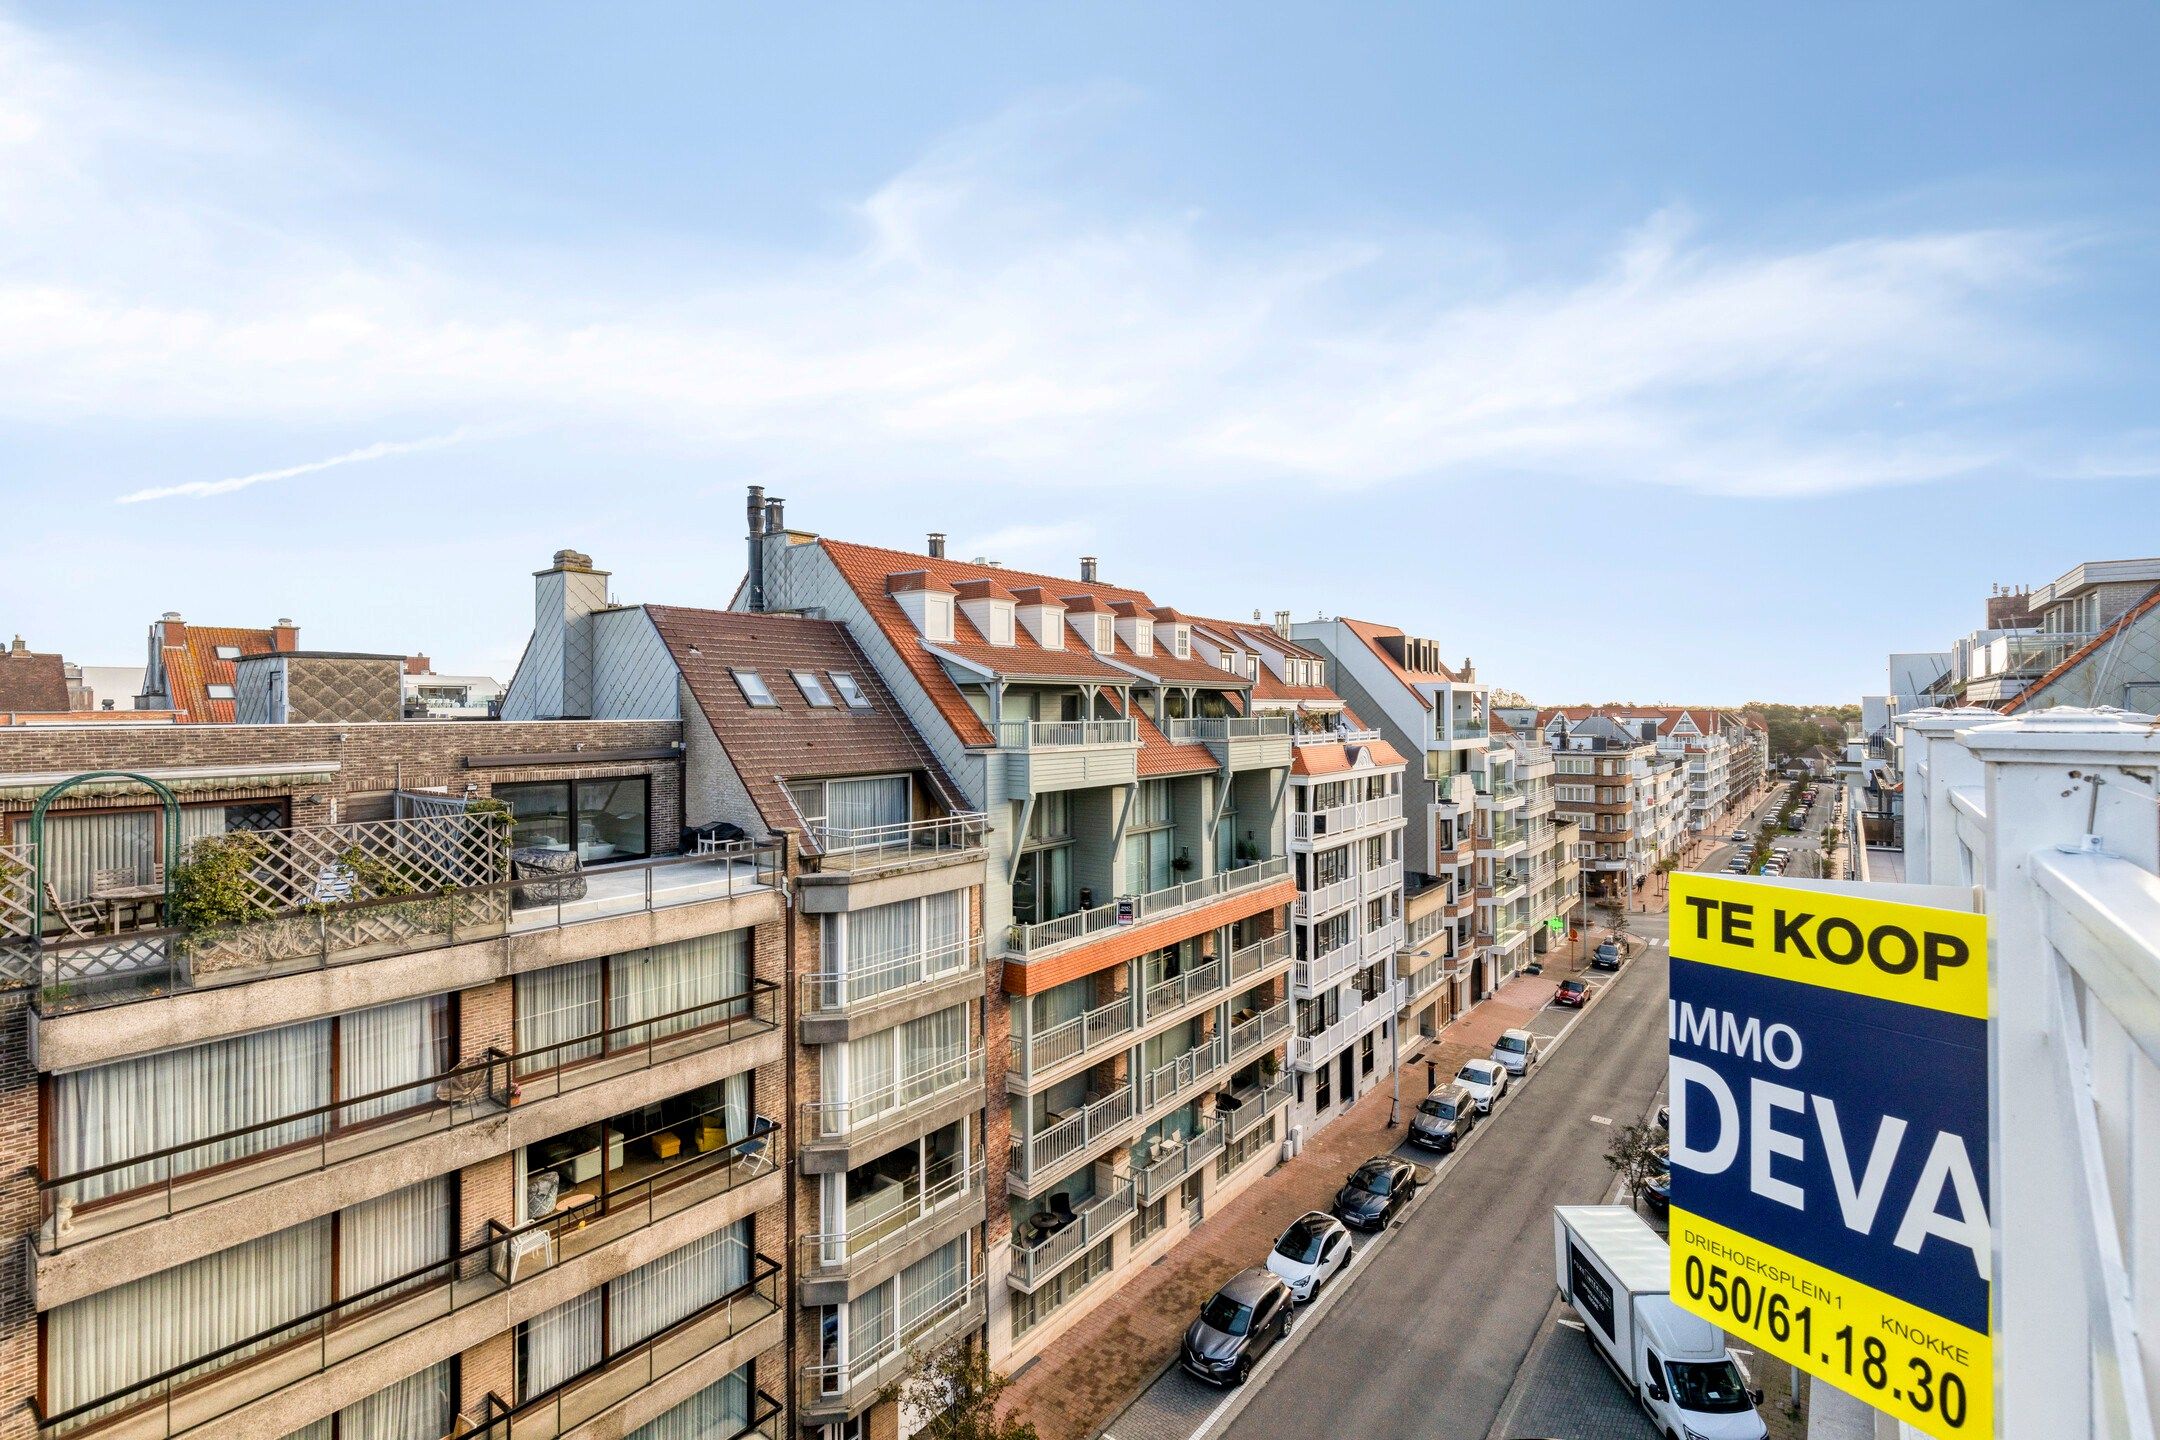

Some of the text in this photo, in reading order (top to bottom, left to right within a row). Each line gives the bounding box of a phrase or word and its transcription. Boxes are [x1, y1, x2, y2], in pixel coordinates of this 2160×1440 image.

[1686, 895, 1970, 982] TE KOOP
[1668, 998, 1803, 1070] IMMO
[1668, 1053, 1992, 1283] DEVA
[1684, 1229, 1969, 1368] DRIEHOEKSPLEIN 1 KNOKKE
[1685, 1254, 1967, 1429] 050/61.18.30
